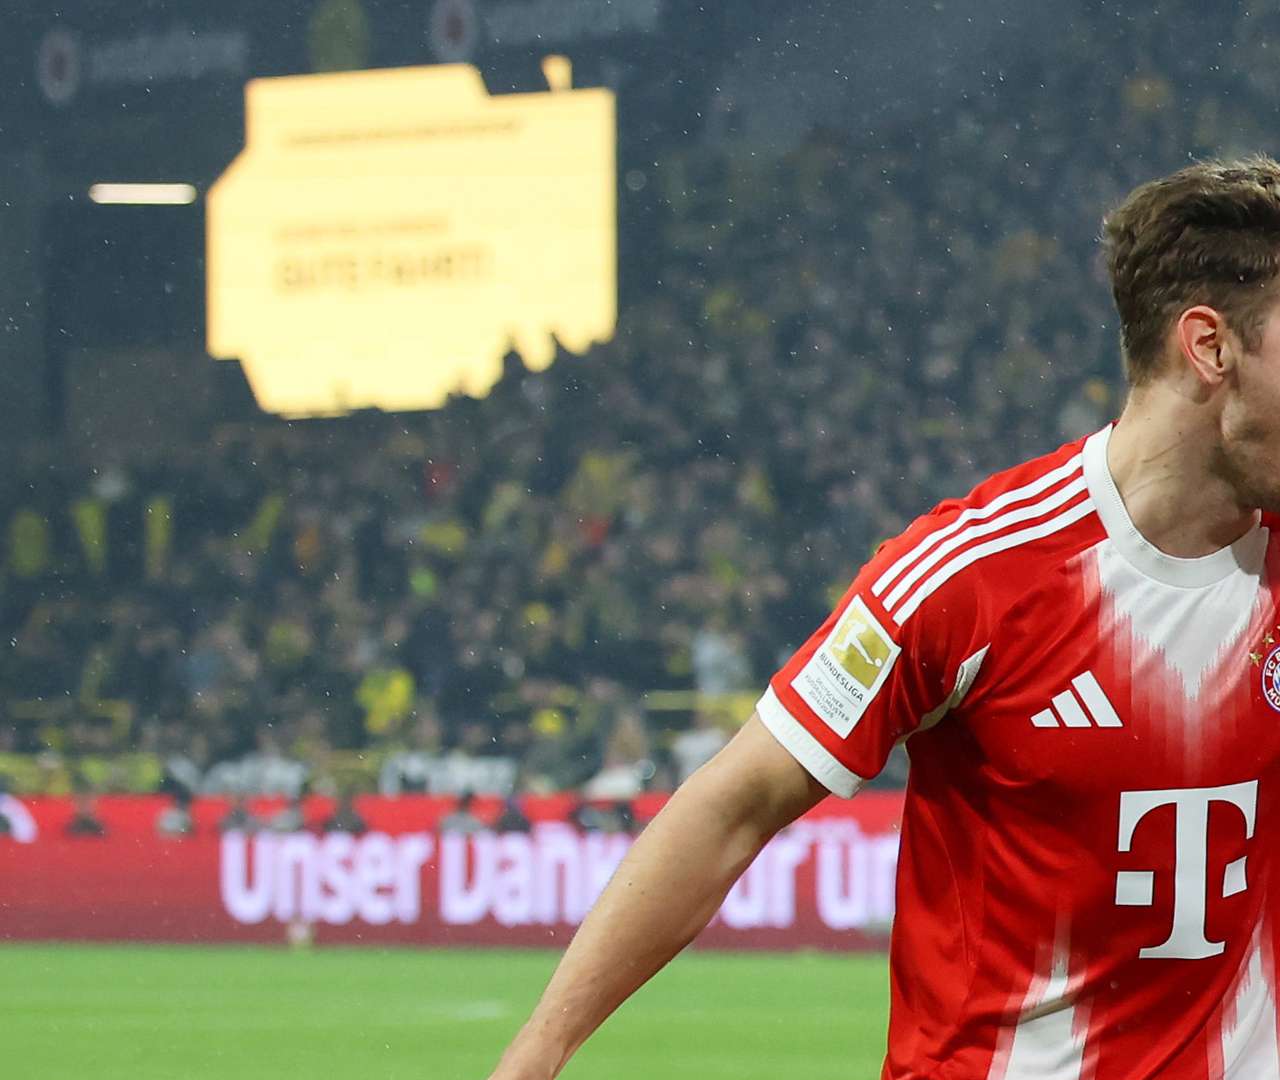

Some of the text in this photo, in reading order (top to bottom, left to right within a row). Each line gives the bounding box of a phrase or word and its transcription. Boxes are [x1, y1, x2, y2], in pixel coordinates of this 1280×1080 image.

[820, 652, 864, 702] BUNDESLIGA
[1265, 660, 1277, 677] FC
[220, 829, 434, 926] Unser
